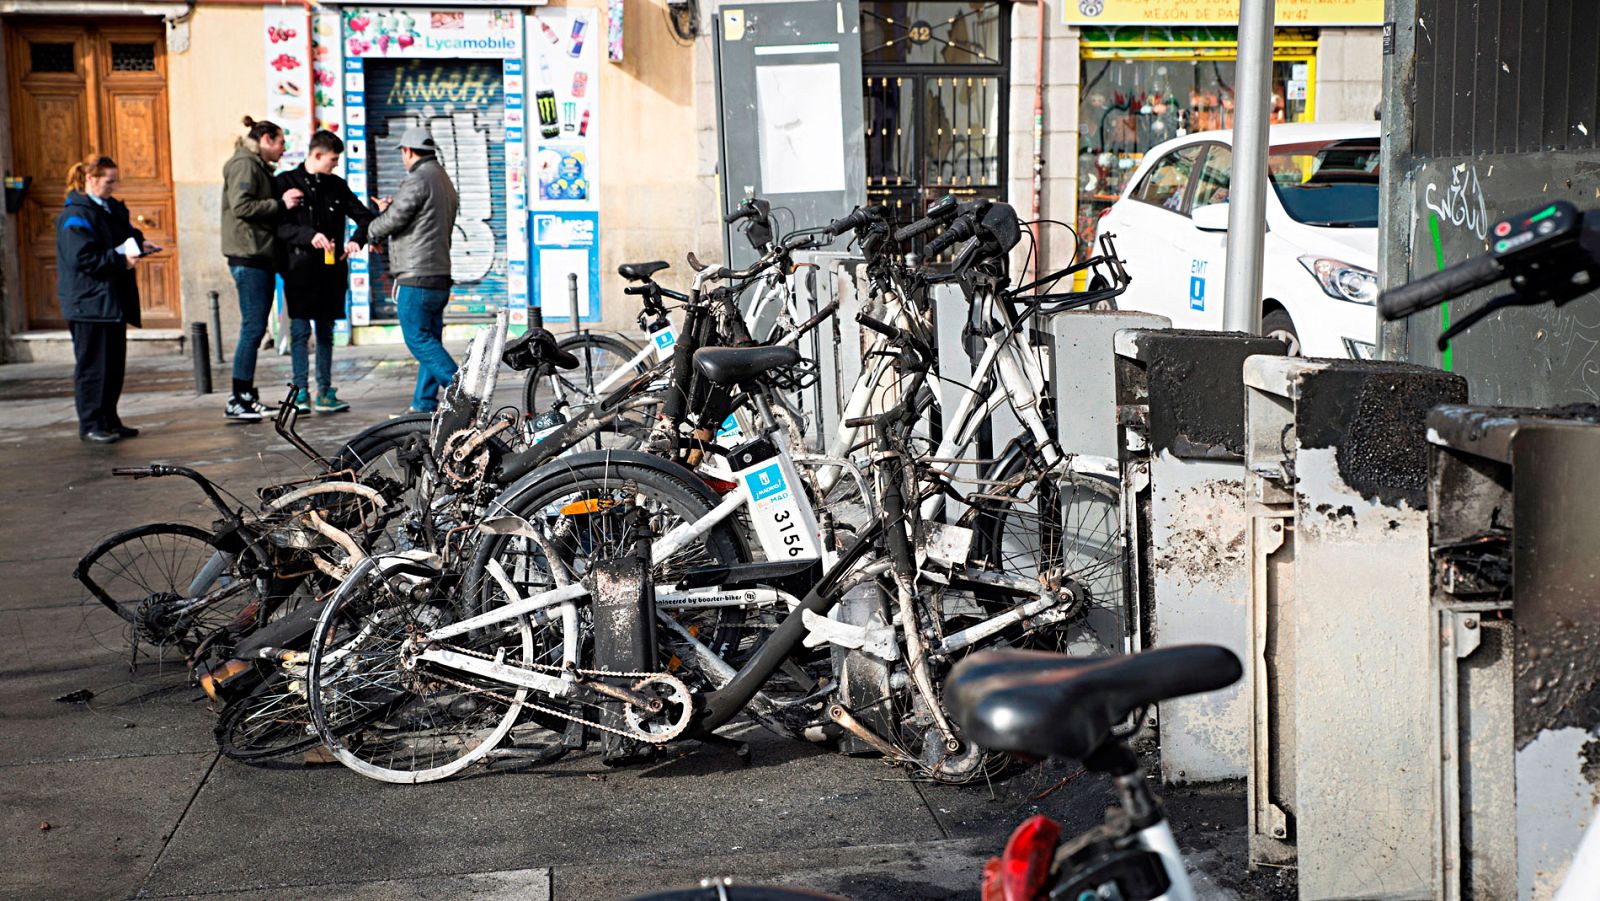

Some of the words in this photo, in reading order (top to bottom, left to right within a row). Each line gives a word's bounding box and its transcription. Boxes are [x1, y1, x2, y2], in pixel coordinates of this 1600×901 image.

[1195, 8, 1211, 19] DE
[909, 27, 930, 41] 42
[426, 36, 516, 51] Lycamobile
[1191, 259, 1209, 276] EMT
[774, 510, 804, 557] 3156
[698, 594, 742, 603] booster-bikes
